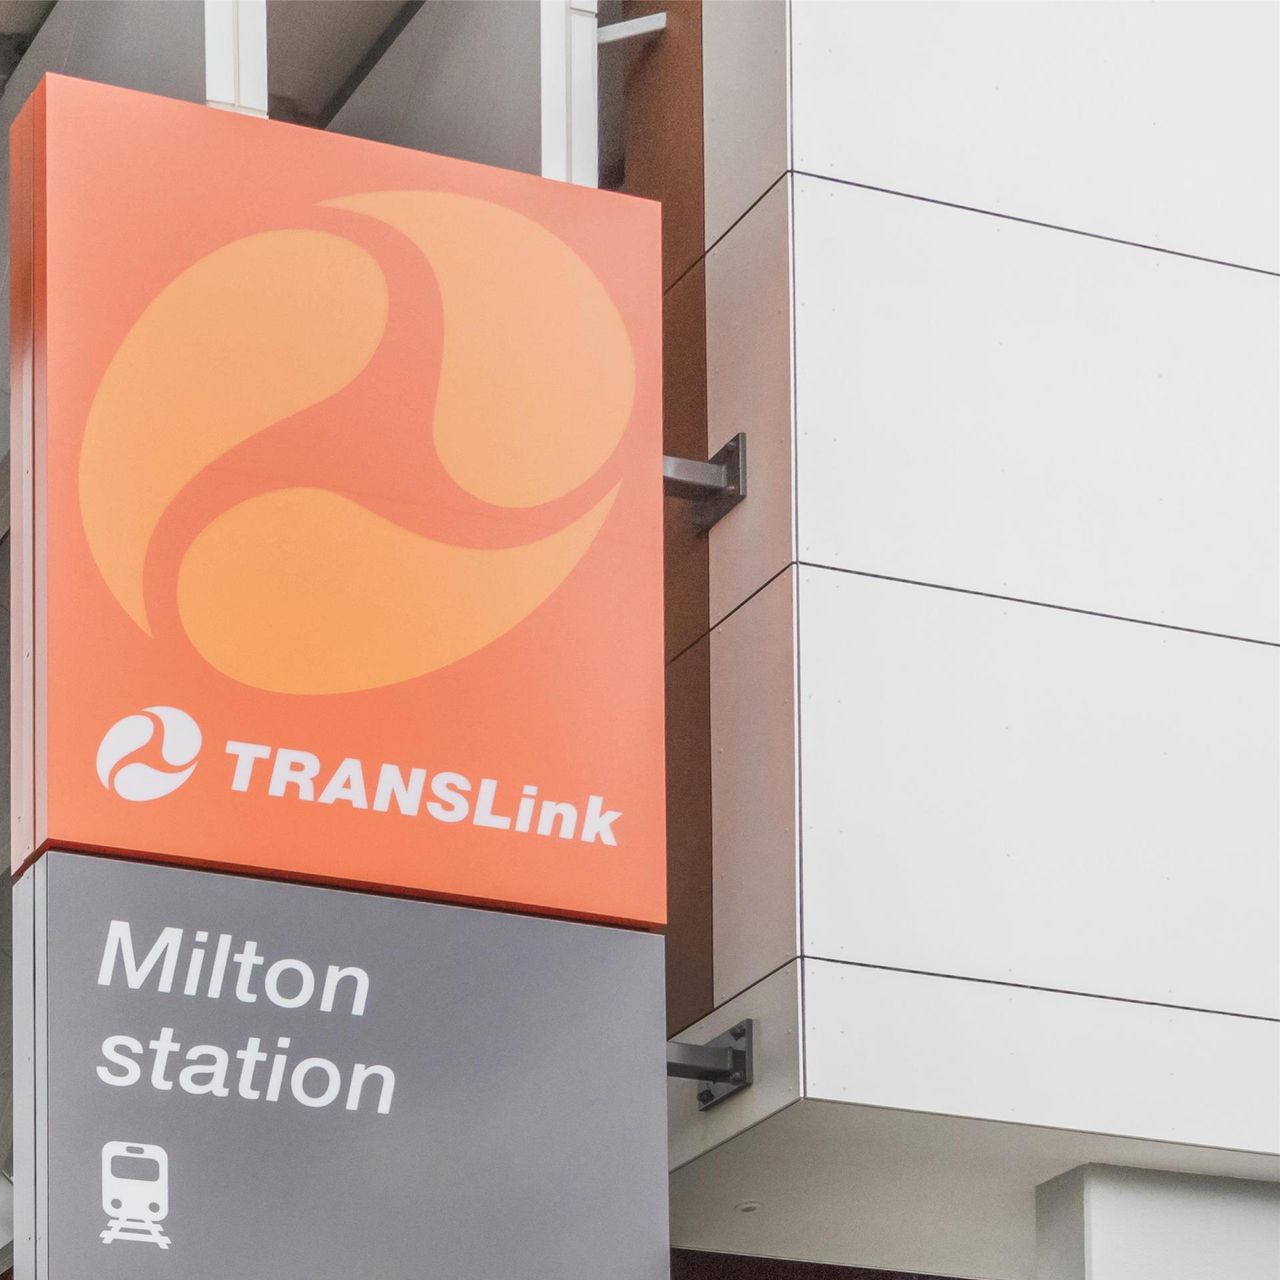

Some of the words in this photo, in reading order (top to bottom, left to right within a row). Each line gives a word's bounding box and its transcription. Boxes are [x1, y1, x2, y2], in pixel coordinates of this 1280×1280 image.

[224, 740, 623, 846] TRANSLink
[97, 919, 370, 1016] Milton
[95, 1026, 396, 1115] station
